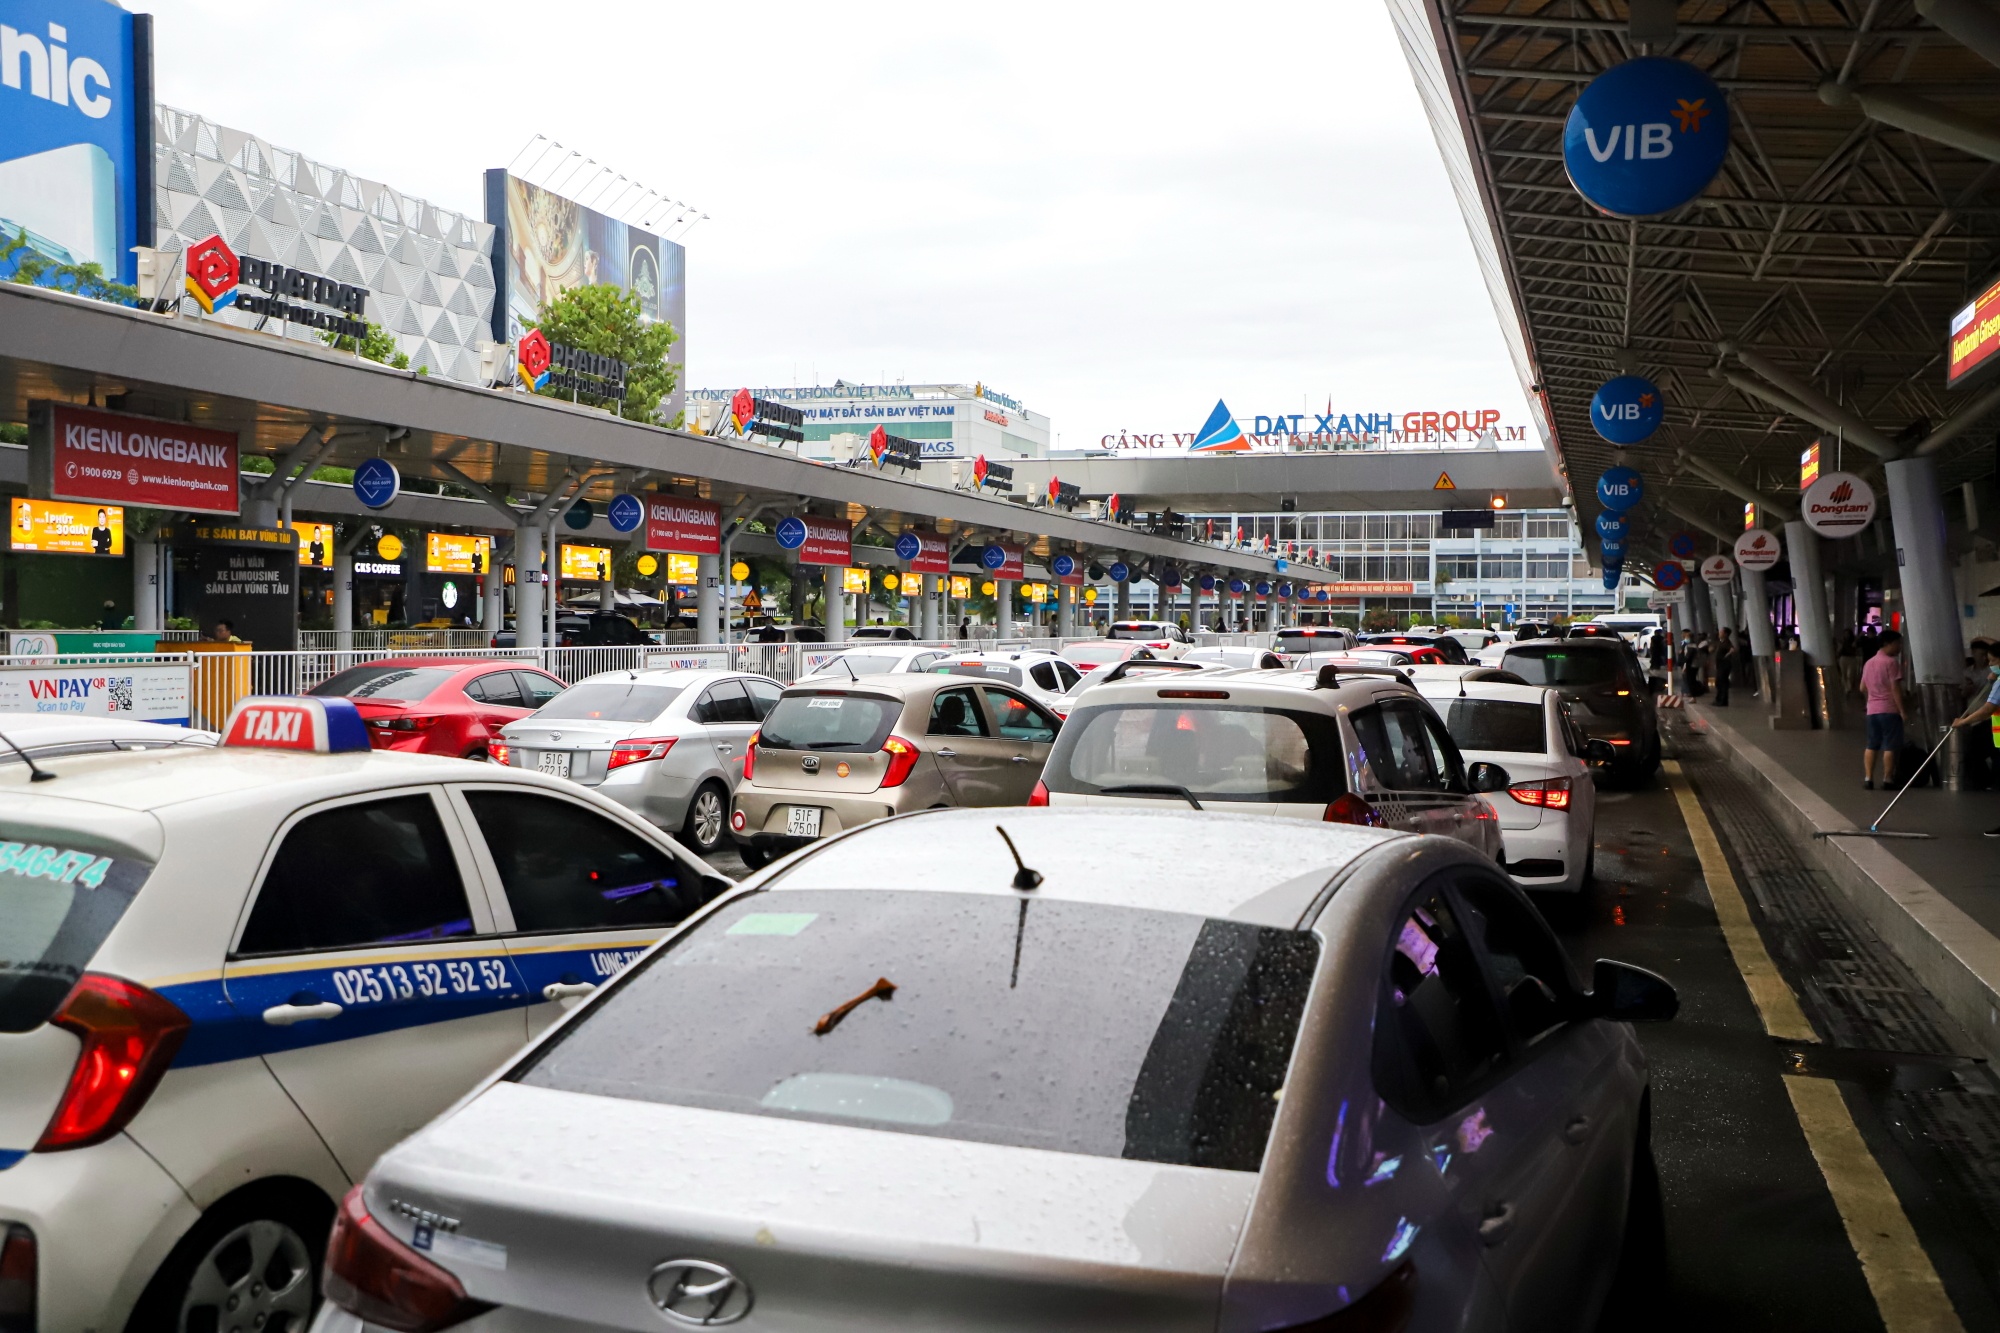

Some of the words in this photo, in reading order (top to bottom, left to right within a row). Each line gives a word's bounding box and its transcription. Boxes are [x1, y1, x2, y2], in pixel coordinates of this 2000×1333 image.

[1584, 123, 1673, 163] VIB
[238, 255, 370, 314] PHATDAT
[795, 384, 843, 401] KHÔNG
[846, 384, 875, 400] VIỆT
[878, 384, 912, 397] NAM
[864, 405, 884, 417] SÂN
[887, 406, 907, 416] BAY
[909, 405, 931, 419] VIỆT
[933, 406, 955, 415] NAM
[1600, 404, 1640, 420] VIB
[1255, 415, 1304, 436] DAT
[1314, 413, 1393, 434] XANH
[1403, 409, 1501, 433] GROUP
[65, 424, 228, 468] KIENLONGBANK
[1101, 429, 1155, 450] CẢNG
[919, 441, 955, 453] IAGS
[81, 466, 100, 478] 1900
[101, 468, 122, 480] 6929
[142, 473, 229, 492] www.kienlongbank.com
[1603, 485, 1629, 496] VIB
[651, 504, 717, 527] KIENLONGBANK
[1811, 503, 1868, 514] Dongtam
[1600, 521, 1620, 530] VIB
[213, 527, 236, 539] SÂN
[239, 529, 258, 540] BAY
[1604, 542, 1620, 550] VIB
[217, 570, 229, 581] XE
[231, 570, 280, 581] LIMOUSINE
[371, 562, 401, 575] COFFEE
[206, 582, 225, 594] SÂN
[226, 584, 242, 594] BAY
[244, 582, 268, 594] VŨNG
[272, 581, 289, 595] TÀU
[36, 702, 57, 712] Scan
[60, 702, 69, 711] to
[71, 701, 86, 712] Pay
[244, 710, 302, 742] TAXI
[545, 753, 563, 765] 51G
[795, 809, 813, 822] 51F
[787, 822, 817, 837] 475.01
[0, 842, 114, 890] 546474
[333, 965, 414, 1005] 02513
[413, 963, 448, 997] 52
[446, 961, 480, 993] 52
[480, 959, 512, 990] 52
